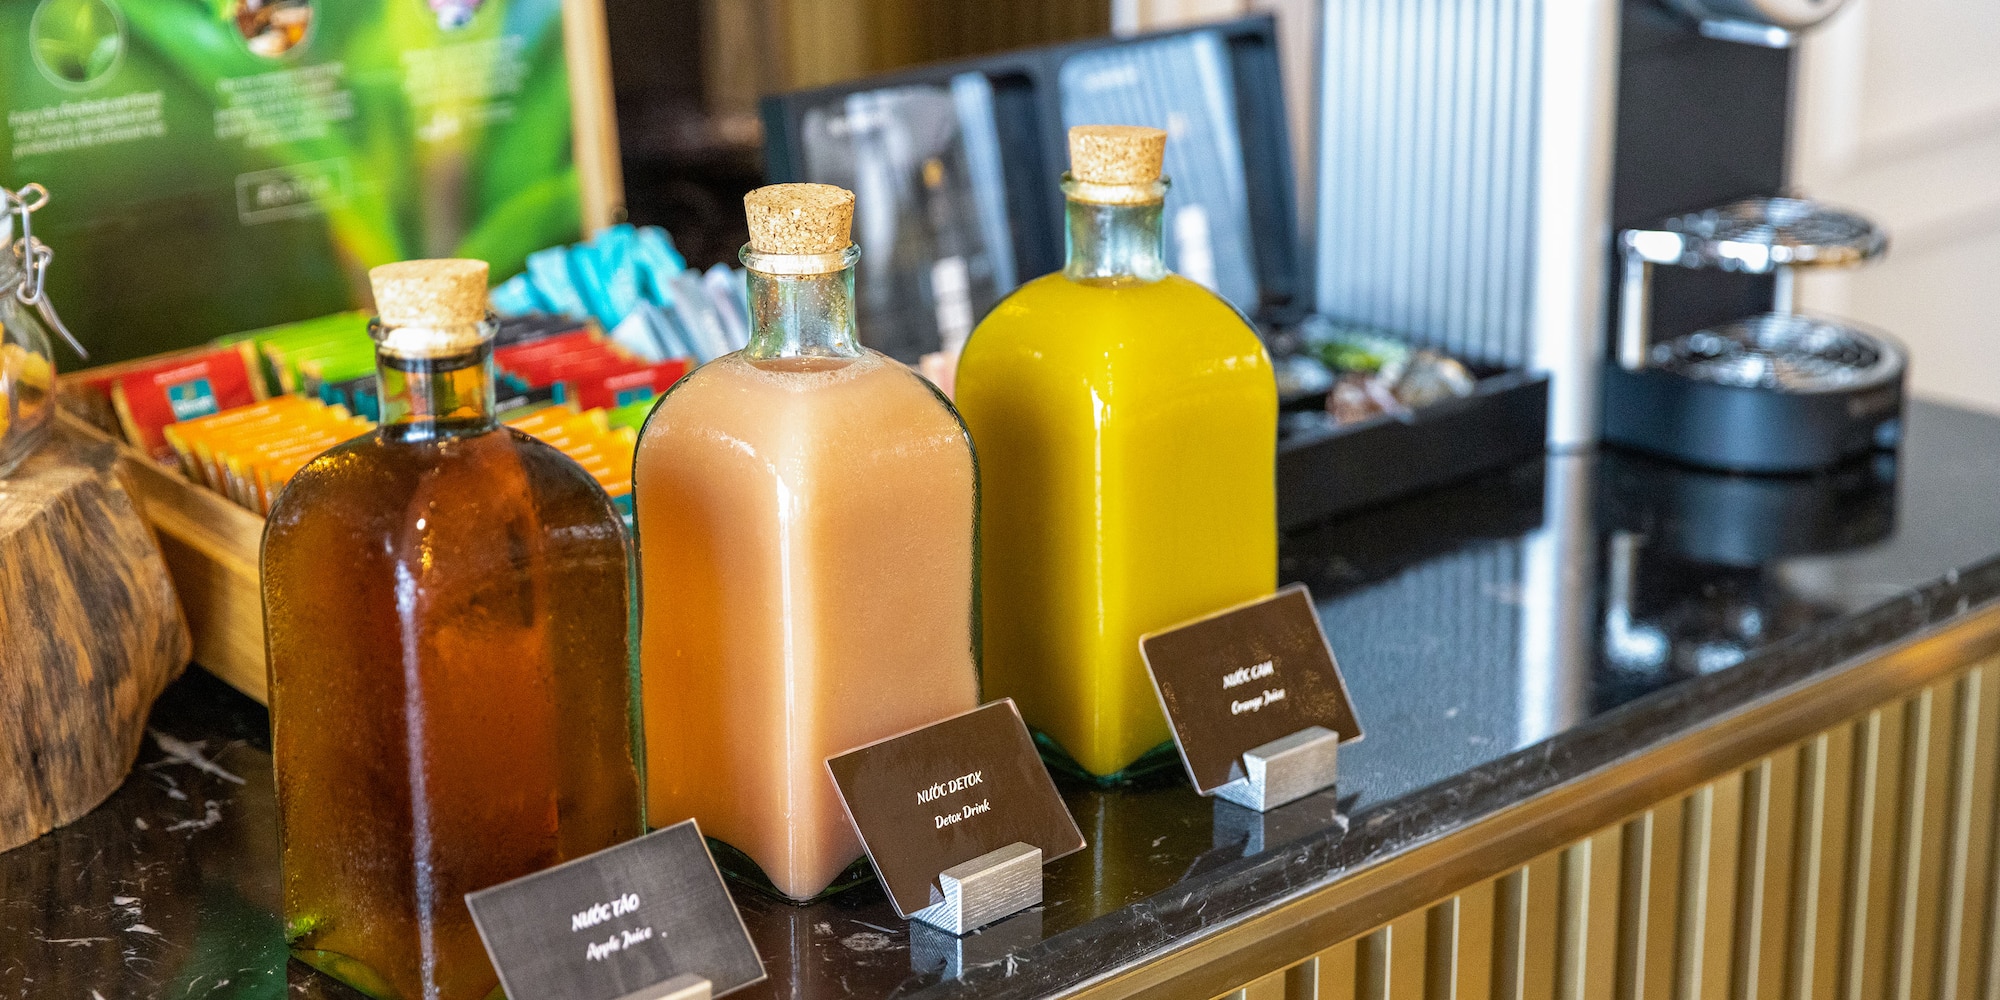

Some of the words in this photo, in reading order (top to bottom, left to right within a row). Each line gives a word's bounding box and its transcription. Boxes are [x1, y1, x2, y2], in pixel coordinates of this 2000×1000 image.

[1231, 696, 1263, 715] Orange
[1262, 688, 1286, 706] Juice
[916, 782, 947, 805] NƯỚC
[948, 770, 984, 794] DETOX
[934, 812, 962, 829] Detox
[962, 798, 991, 819] Drink
[586, 935, 620, 962] Apple
[621, 926, 653, 950] Juice
